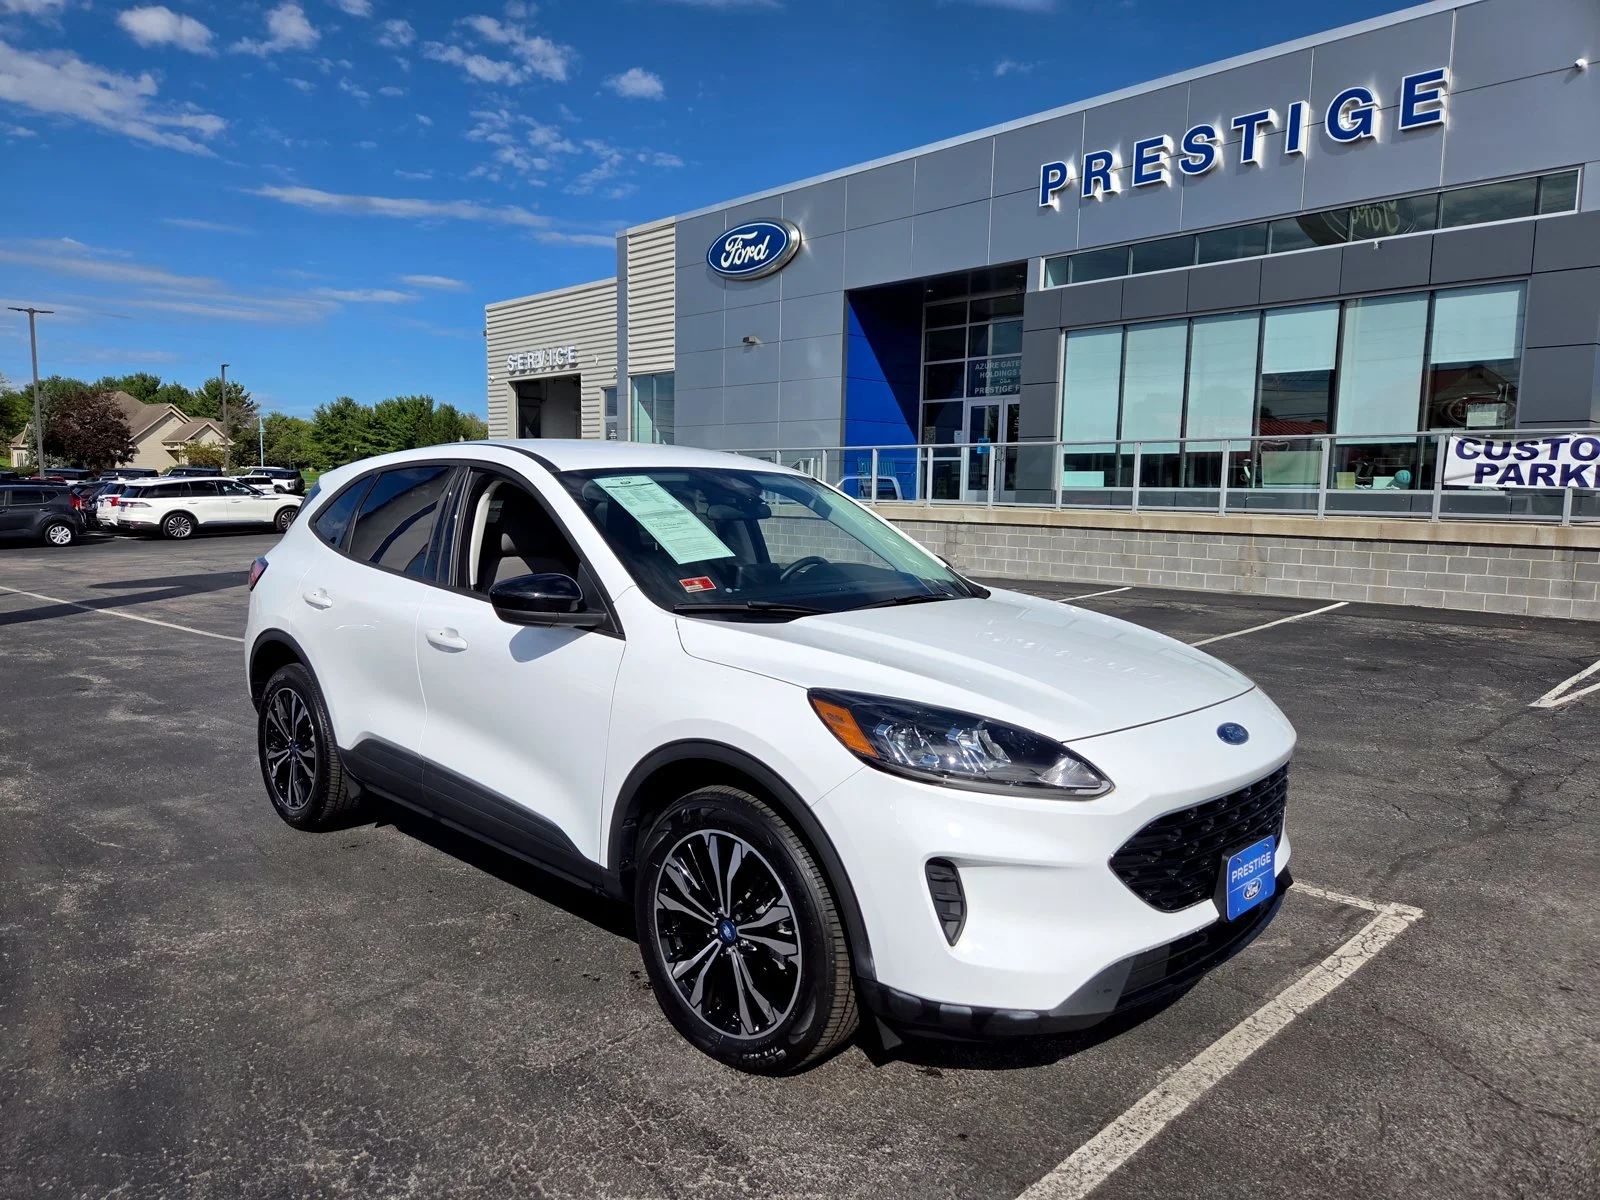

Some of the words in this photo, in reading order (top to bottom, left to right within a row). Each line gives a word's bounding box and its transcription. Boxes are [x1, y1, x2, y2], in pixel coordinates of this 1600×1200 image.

[1039, 66, 1450, 208] PRESTIGE
[721, 231, 771, 268] Ford
[507, 346, 577, 372] SERVICE
[975, 362, 1000, 371] AZURE
[979, 368, 1017, 379] HOLDINGS
[974, 385, 1013, 394] PRESTIGE
[1455, 437, 1600, 462] CUSTO
[1231, 851, 1272, 883] PRESTIGE
